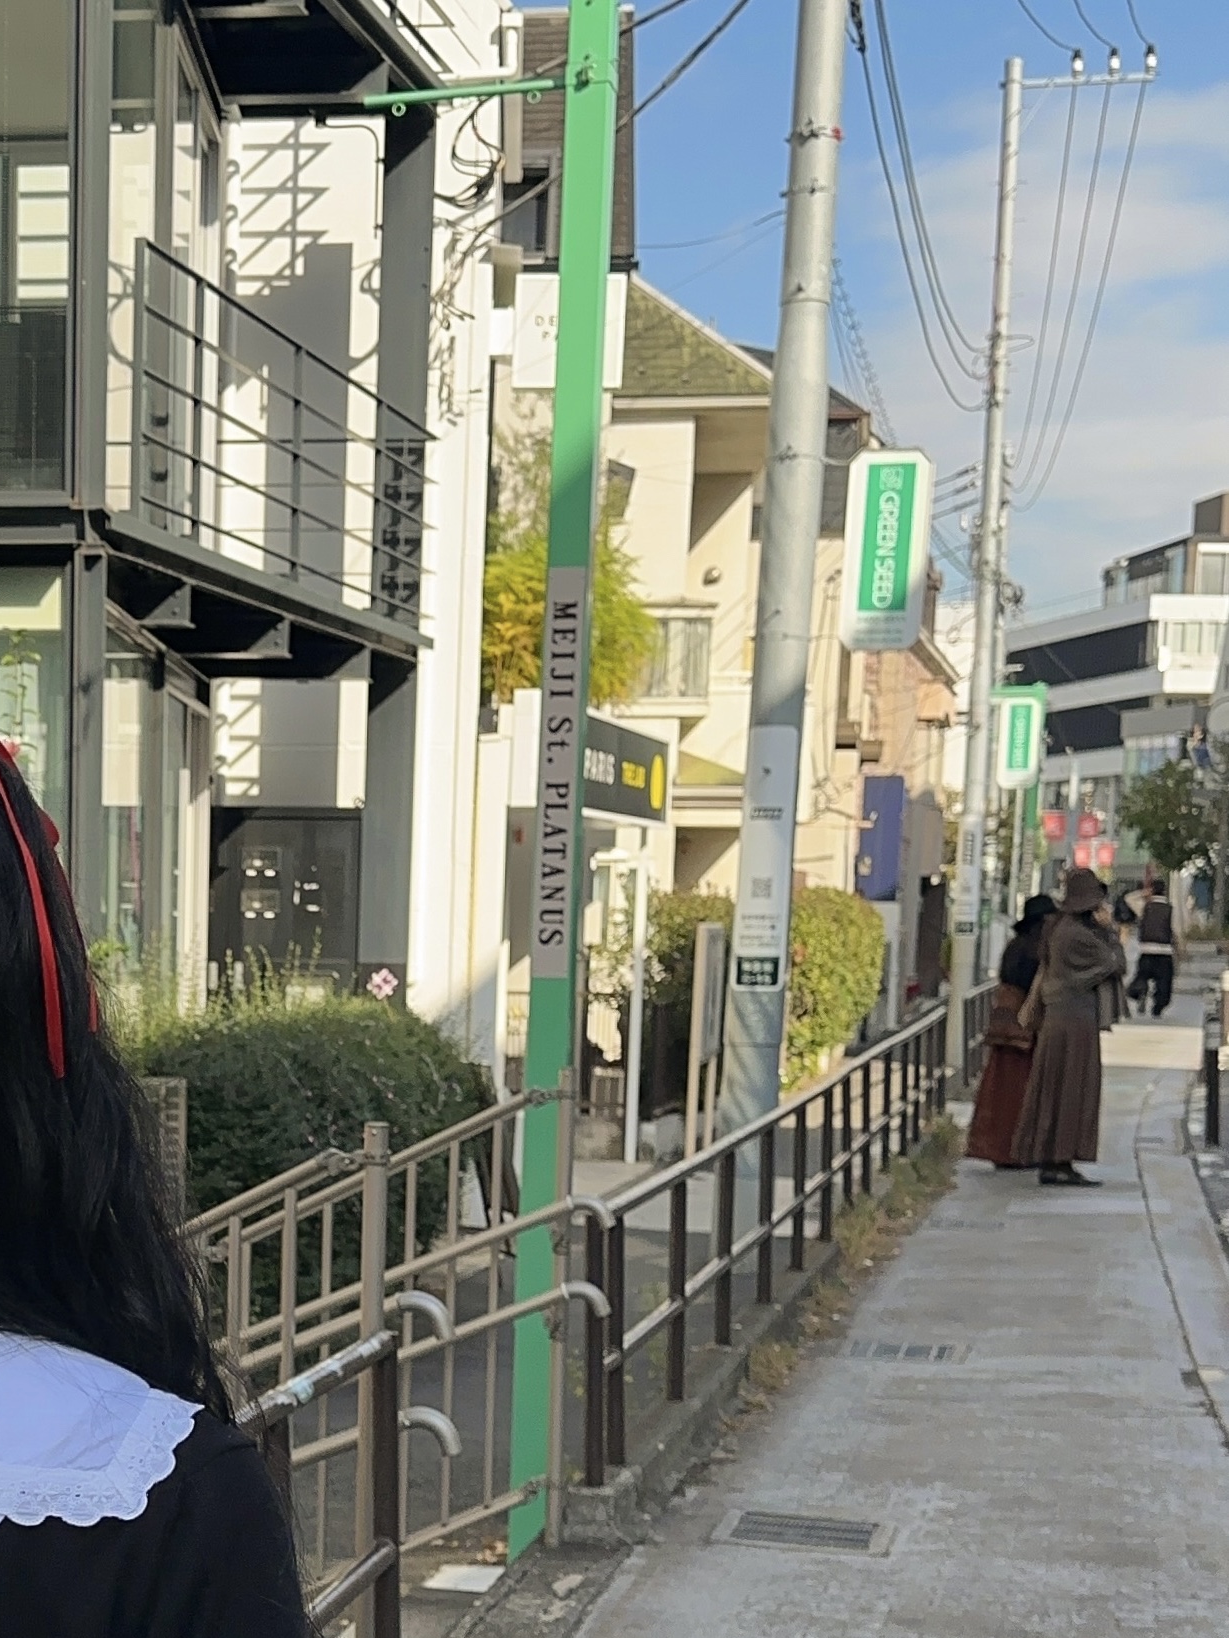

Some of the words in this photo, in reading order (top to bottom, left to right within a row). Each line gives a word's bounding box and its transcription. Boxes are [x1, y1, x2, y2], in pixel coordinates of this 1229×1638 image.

[549, 601, 578, 698] MEIJI
[546, 716, 573, 764] St.
[538, 782, 570, 946] PLATANUS
